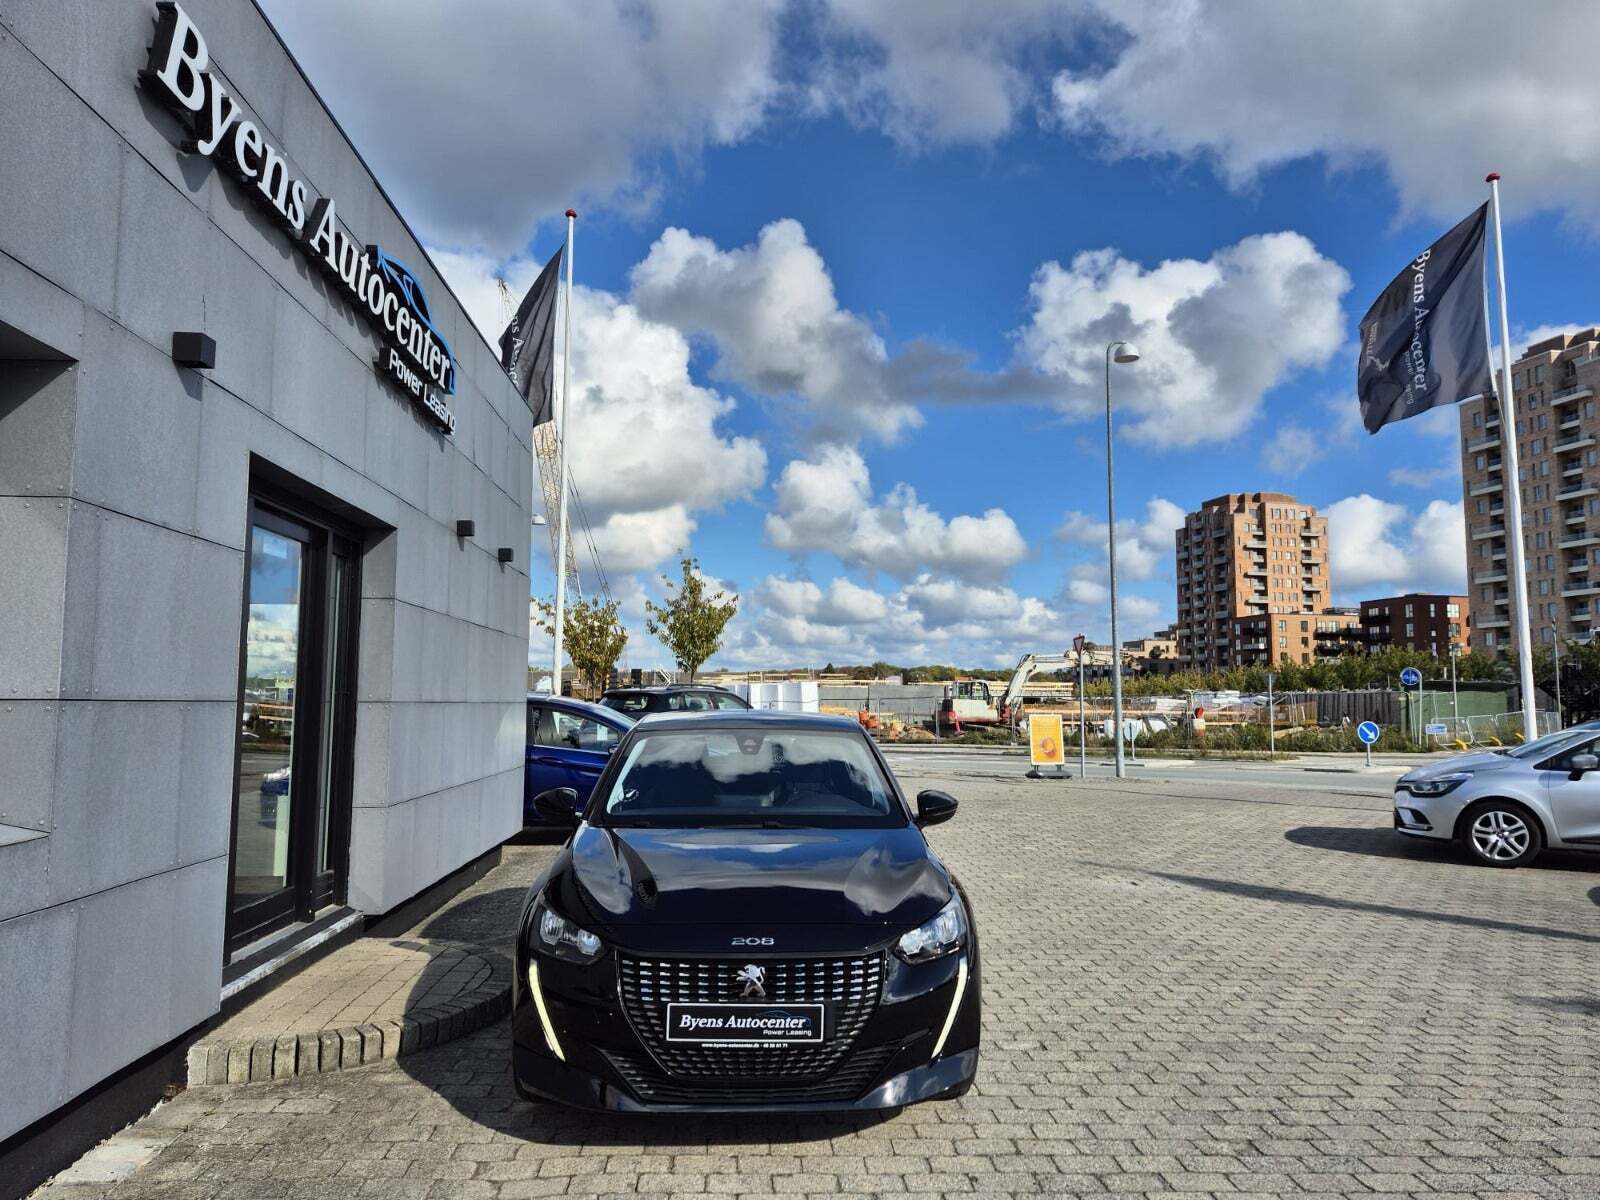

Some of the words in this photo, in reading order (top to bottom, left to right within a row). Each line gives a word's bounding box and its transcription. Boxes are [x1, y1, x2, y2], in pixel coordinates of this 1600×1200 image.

[156, 1, 309, 231] Byens
[309, 198, 452, 391] Autocenter
[1411, 249, 1431, 304] Byens
[389, 346, 423, 397] Power
[423, 383, 457, 437] Leasing
[731, 937, 775, 946] 208
[679, 1014, 723, 1031] Byens
[724, 1014, 807, 1029] Autocenter
[786, 1029, 812, 1037] Leasing
